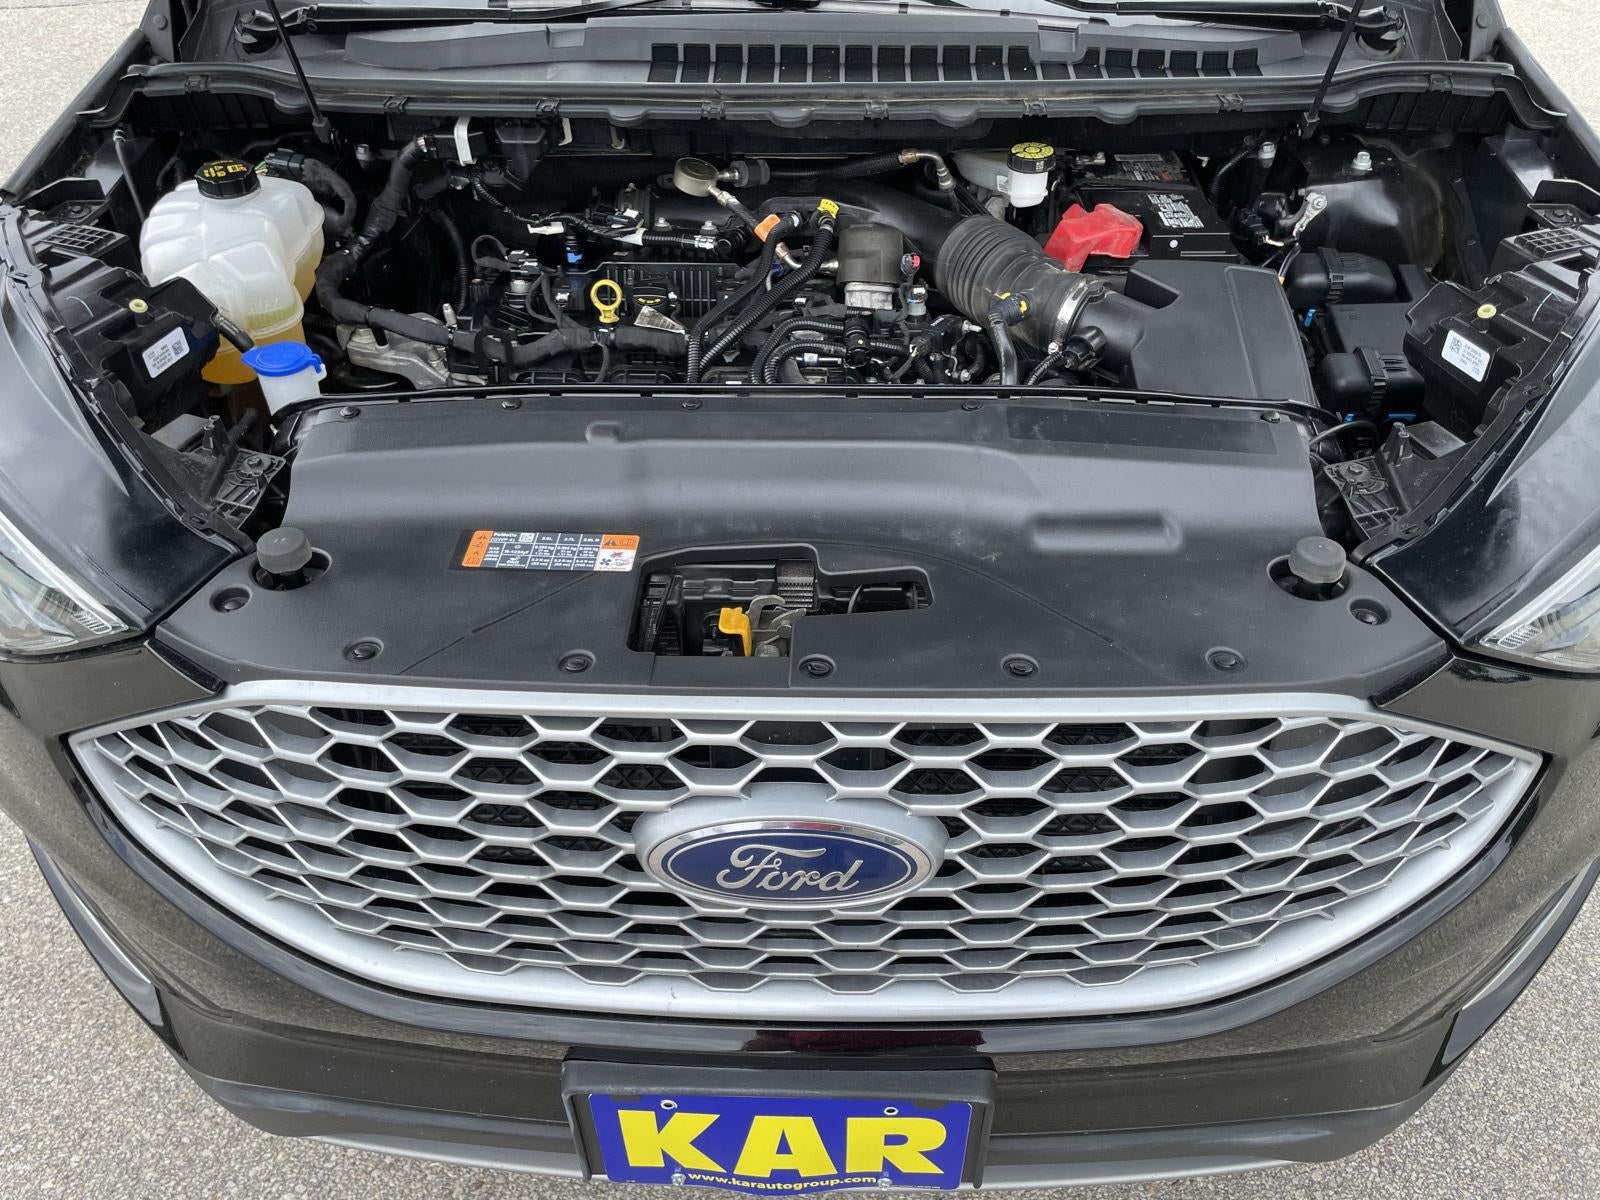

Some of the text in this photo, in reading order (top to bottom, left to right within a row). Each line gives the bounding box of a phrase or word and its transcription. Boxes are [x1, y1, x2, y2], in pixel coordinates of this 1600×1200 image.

[716, 844, 864, 891] Ford
[617, 1109, 947, 1178] KAR
[688, 1172, 878, 1190] www.karautogroup.com
